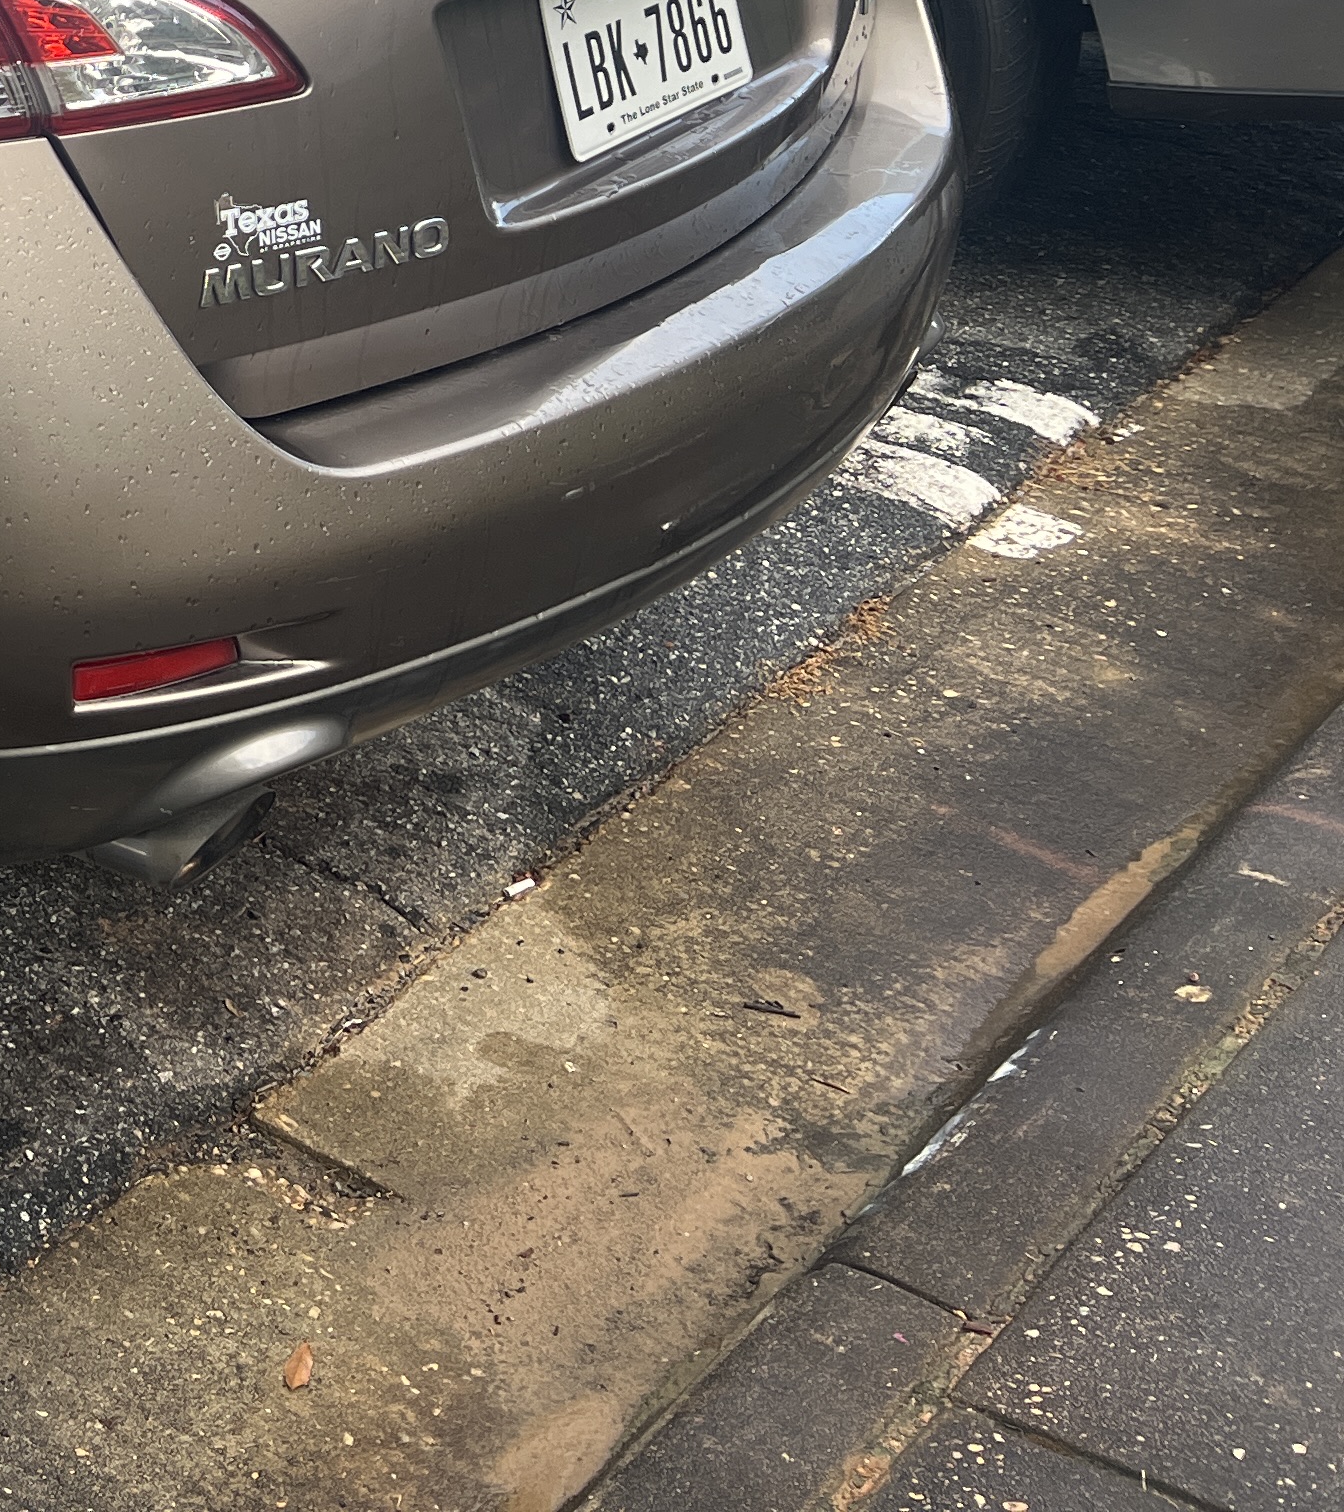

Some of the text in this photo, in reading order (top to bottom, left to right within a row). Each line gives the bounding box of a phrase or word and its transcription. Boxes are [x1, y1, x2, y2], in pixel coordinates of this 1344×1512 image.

[562, 18, 637, 122] LBK
[620, 80, 704, 125] The Lone Star State
[219, 199, 310, 237] Texas
[258, 218, 321, 247] NISSAN
[199, 216, 450, 309] MURANO
